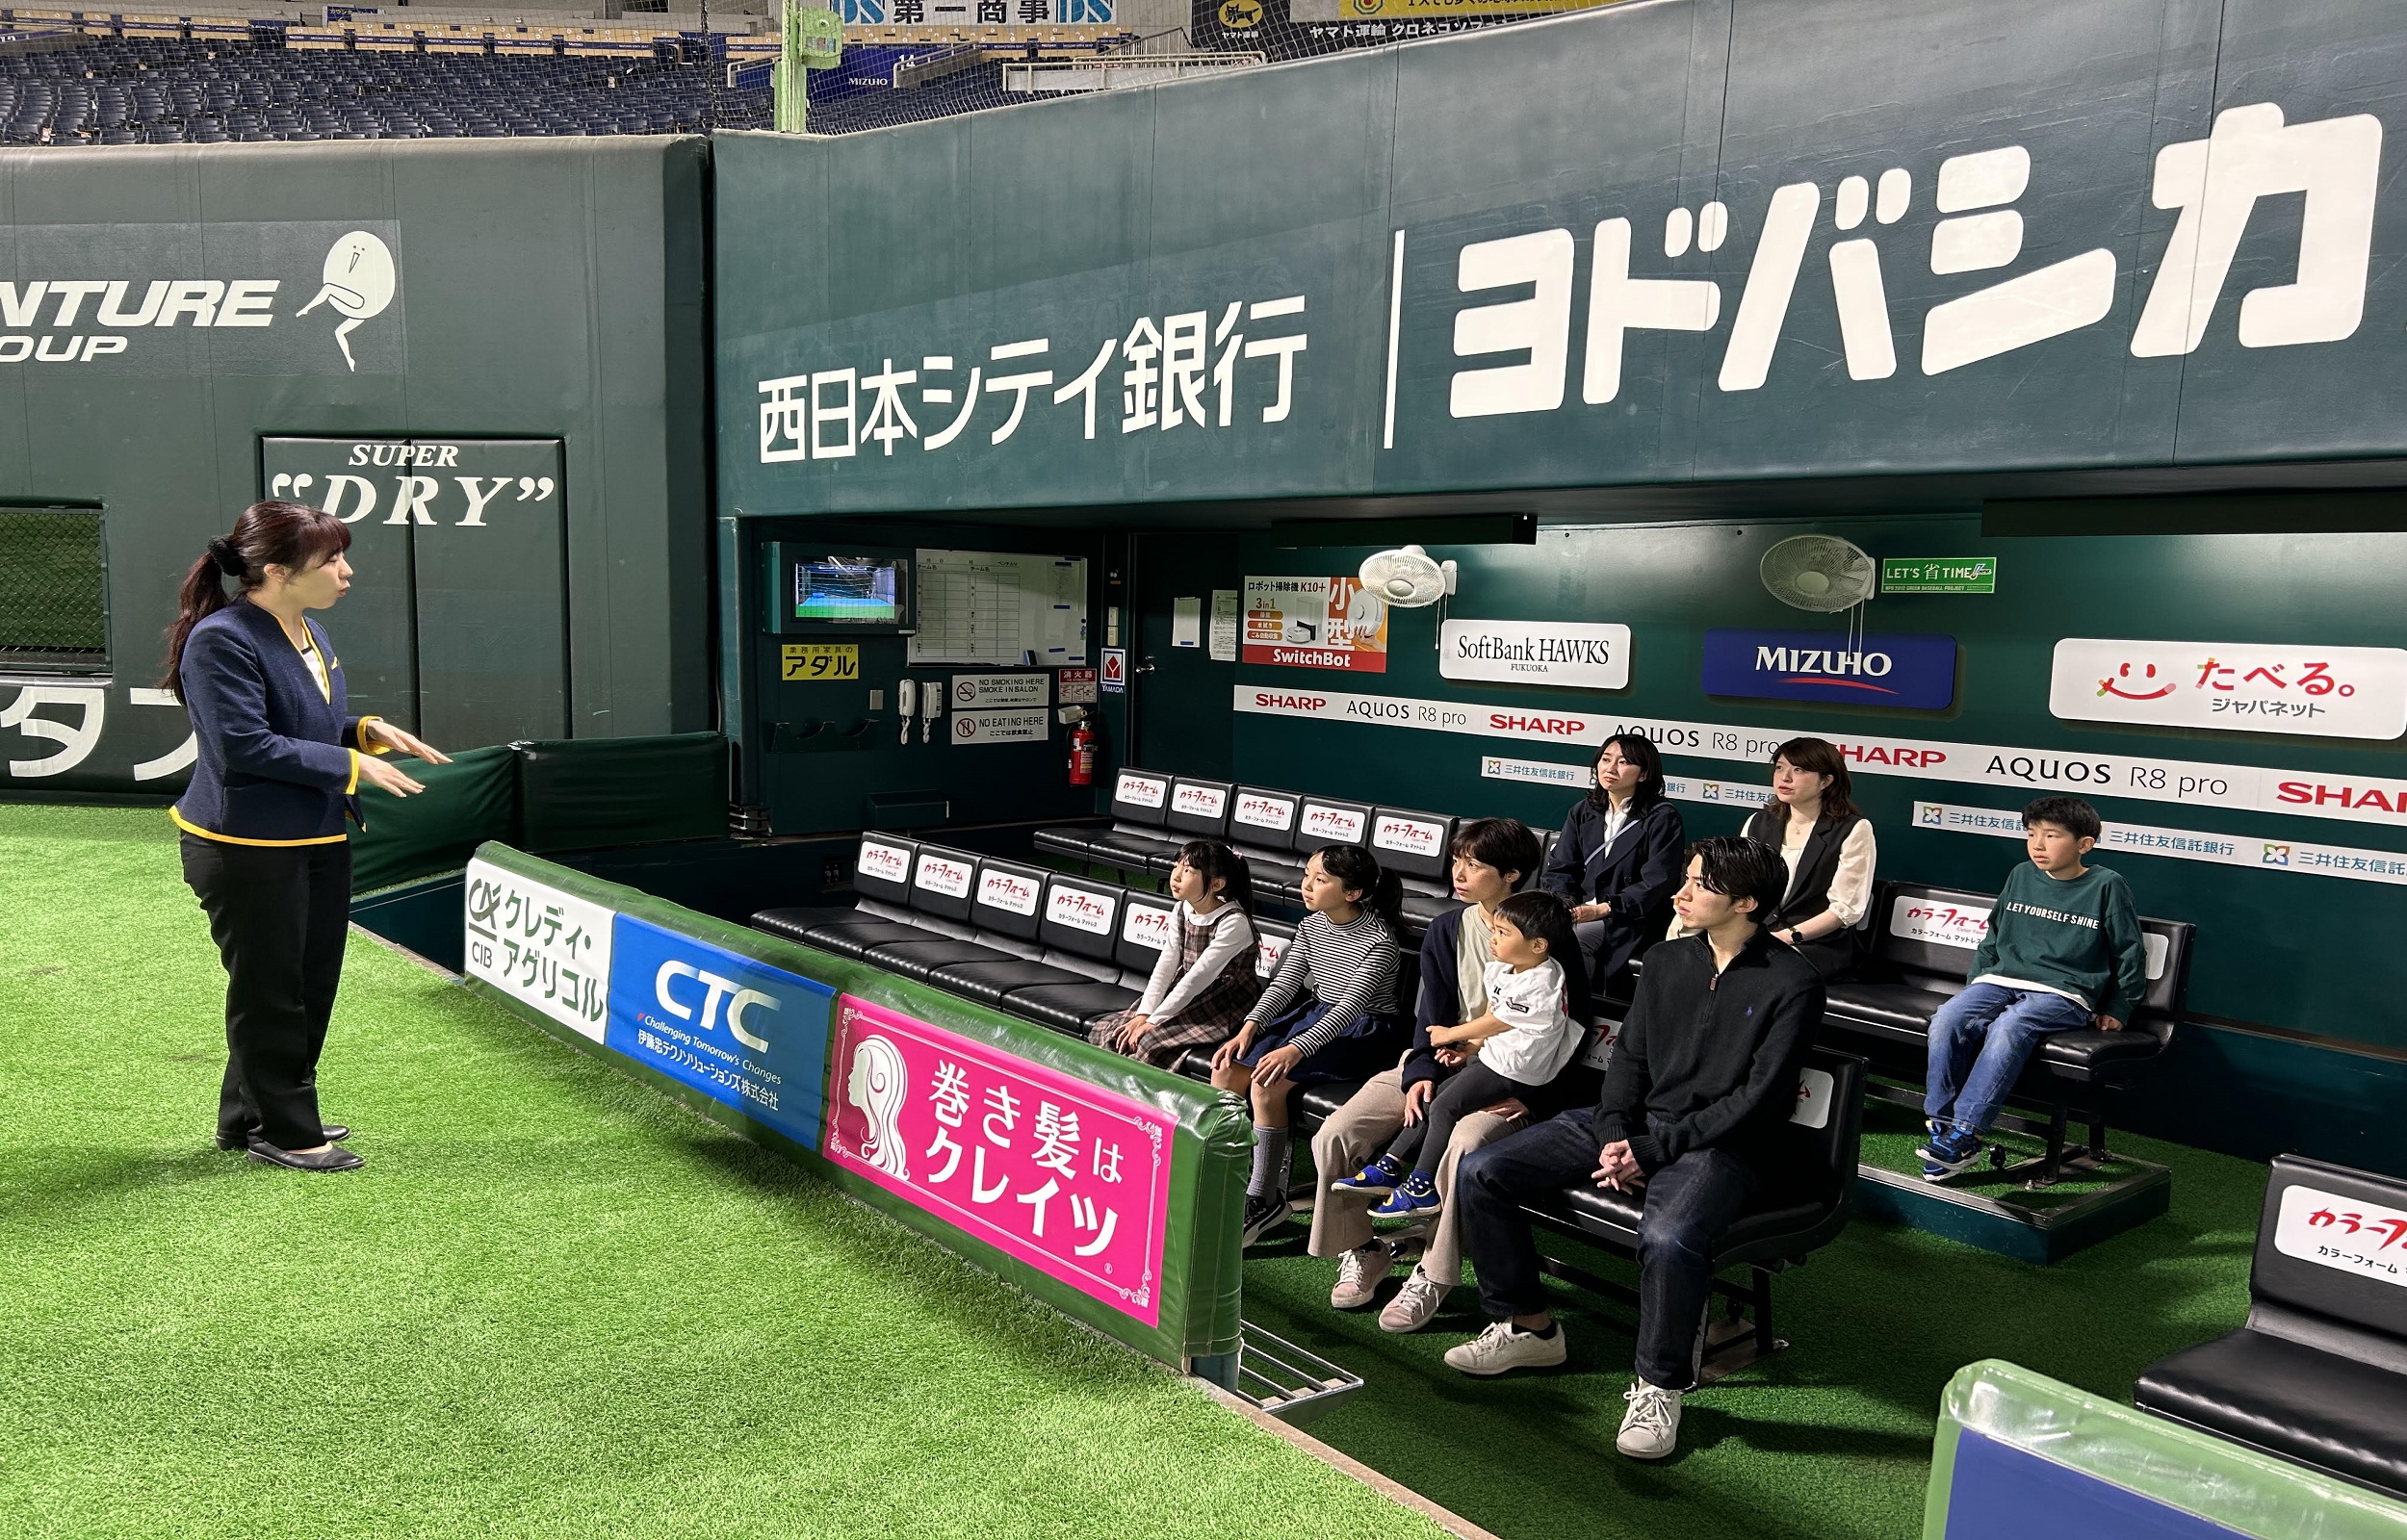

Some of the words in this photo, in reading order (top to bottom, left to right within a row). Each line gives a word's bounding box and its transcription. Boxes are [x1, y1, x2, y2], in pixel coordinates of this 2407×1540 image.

[1309, 24, 1386, 39] ヤマト運輸
[1448, 101, 2384, 418] ヨドバシカ
[0, 280, 280, 327] NTURE
[0, 336, 129, 363] OUP
[758, 294, 1307, 464] 西日本シティ銀行
[348, 444, 459, 468] SUPER
[1886, 567, 1920, 578] LET'S
[1923, 563, 1940, 580] 省
[1942, 567, 1972, 578] TIME
[1248, 581, 1299, 592] ロボット掃除機
[1300, 581, 1326, 593] K10+
[789, 646, 853, 654] 業務用家具の
[1273, 648, 1351, 668] SwitchBot
[1457, 634, 1536, 661] SoftBank
[1538, 638, 1610, 665] HAWKS
[1755, 646, 1892, 678] MIZUHO
[785, 655, 856, 677] アダル
[1511, 663, 1548, 672] FUKUOKA
[1101, 684, 1124, 694] YAMADA
[978, 718, 991, 728] NO
[992, 717, 1022, 728] EATING
[1022, 716, 1044, 726] HERE
[1255, 693, 1327, 710] SHARP
[1347, 700, 1410, 720] AQUOS
[1418, 706, 1436, 722] R8
[1442, 710, 1466, 727] pro
[2212, 699, 2326, 719] ジャパネット
[1488, 713, 1586, 735] SHARP
[1712, 732, 1737, 751] R8
[1746, 737, 1781, 757] pro
[1504, 764, 1575, 781] 三井住友信託銀行
[1835, 744, 1947, 768] HARP
[1985, 755, 2111, 784] AQUOS
[2130, 766, 2166, 789] R8
[2178, 776, 2228, 798] pro
[2109, 830, 2236, 856] 三井住友信託銀行
[2297, 851, 2407, 876] 三井住友信託
[1134, 912, 1169, 933] カラーフ
[2006, 901, 2022, 912] LET
[2023, 903, 2069, 923] YOURSELF
[2070, 914, 2099, 930] SHINE
[1910, 927, 1952, 940] カラーフォーム
[472, 940, 493, 969] CIB
[504, 936, 605, 1023] アグリコル
[656, 959, 782, 1054] CTC
[644, 1015, 691, 1045] Challenging
[692, 1036, 740, 1065] Tomorrow's
[742, 1060, 782, 1085] Changes
[637, 1028, 779, 1112] 伊藤忠テクノソリューションズ株式会社
[928, 1059, 1125, 1185] 巻き髪は
[925, 1126, 1119, 1257] クレイツ
[2308, 1206, 2407, 1251] カラーフ
[2317, 1245, 2398, 1274] カラーフォーム
